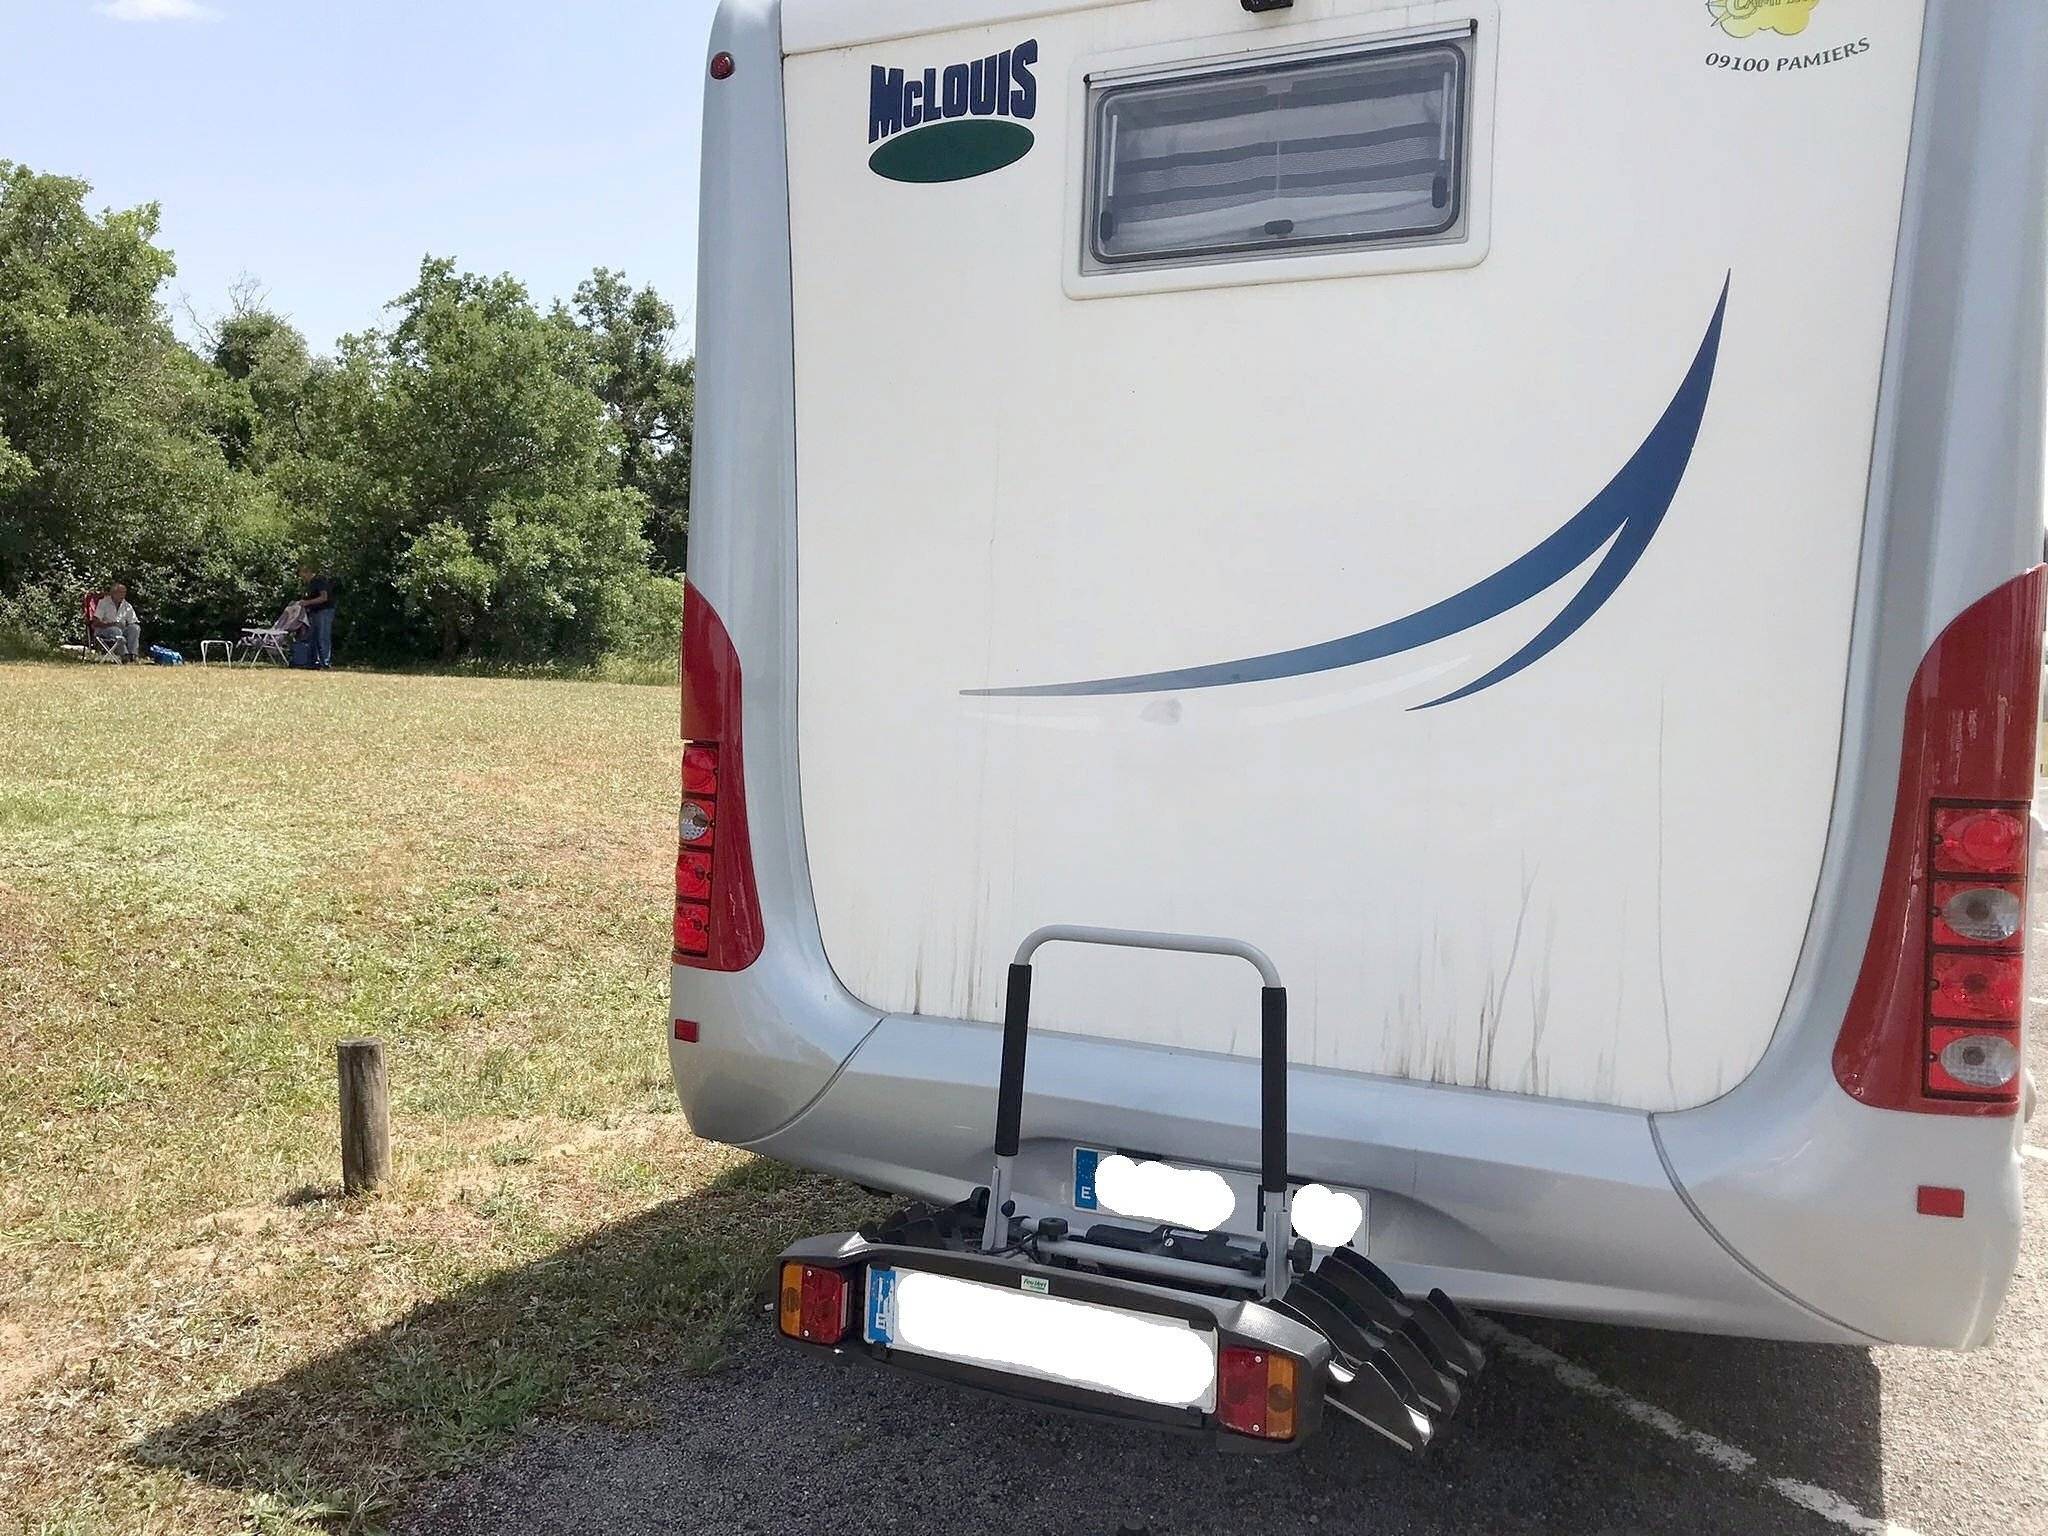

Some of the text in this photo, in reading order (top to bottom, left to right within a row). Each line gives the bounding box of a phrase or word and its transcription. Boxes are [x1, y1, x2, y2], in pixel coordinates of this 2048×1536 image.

[1705, 37, 1870, 72] 09100 PAMIERS
[1081, 1185, 1091, 1200] E
